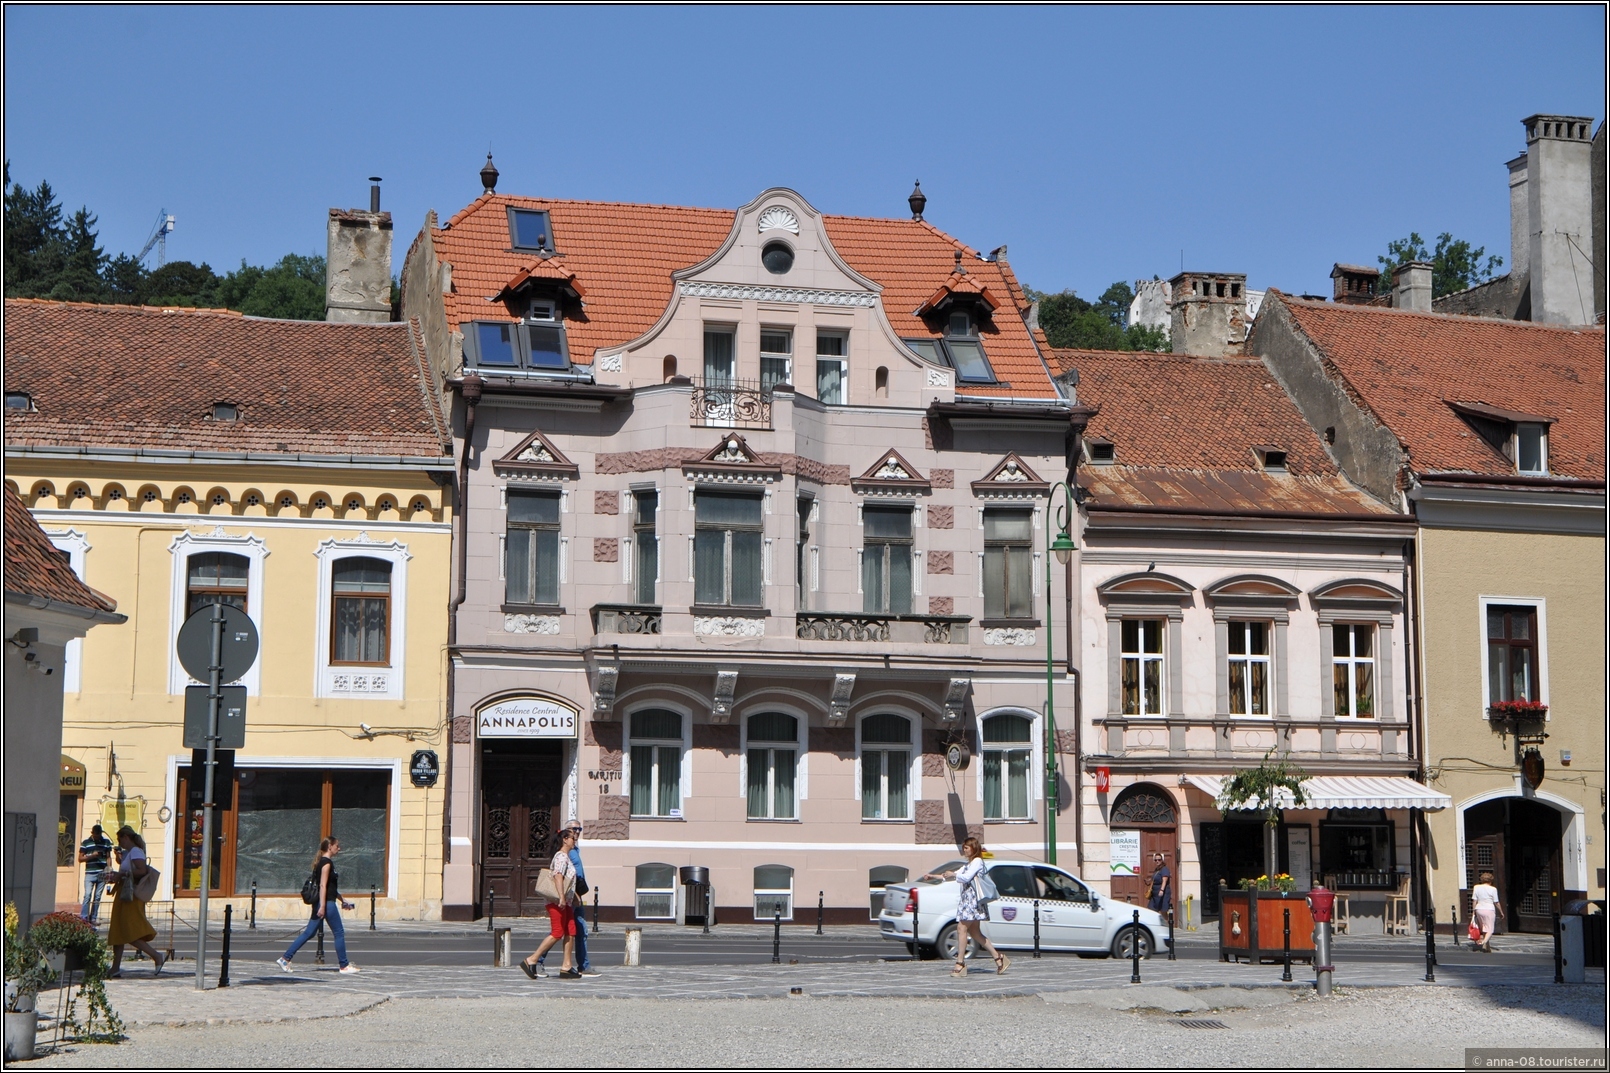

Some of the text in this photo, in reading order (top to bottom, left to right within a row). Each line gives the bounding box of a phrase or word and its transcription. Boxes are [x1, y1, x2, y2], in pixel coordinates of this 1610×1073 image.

[494, 705, 560, 715] Residence Central
[481, 717, 573, 728] ANNAPOLIS
[599, 784, 609, 794] 18
